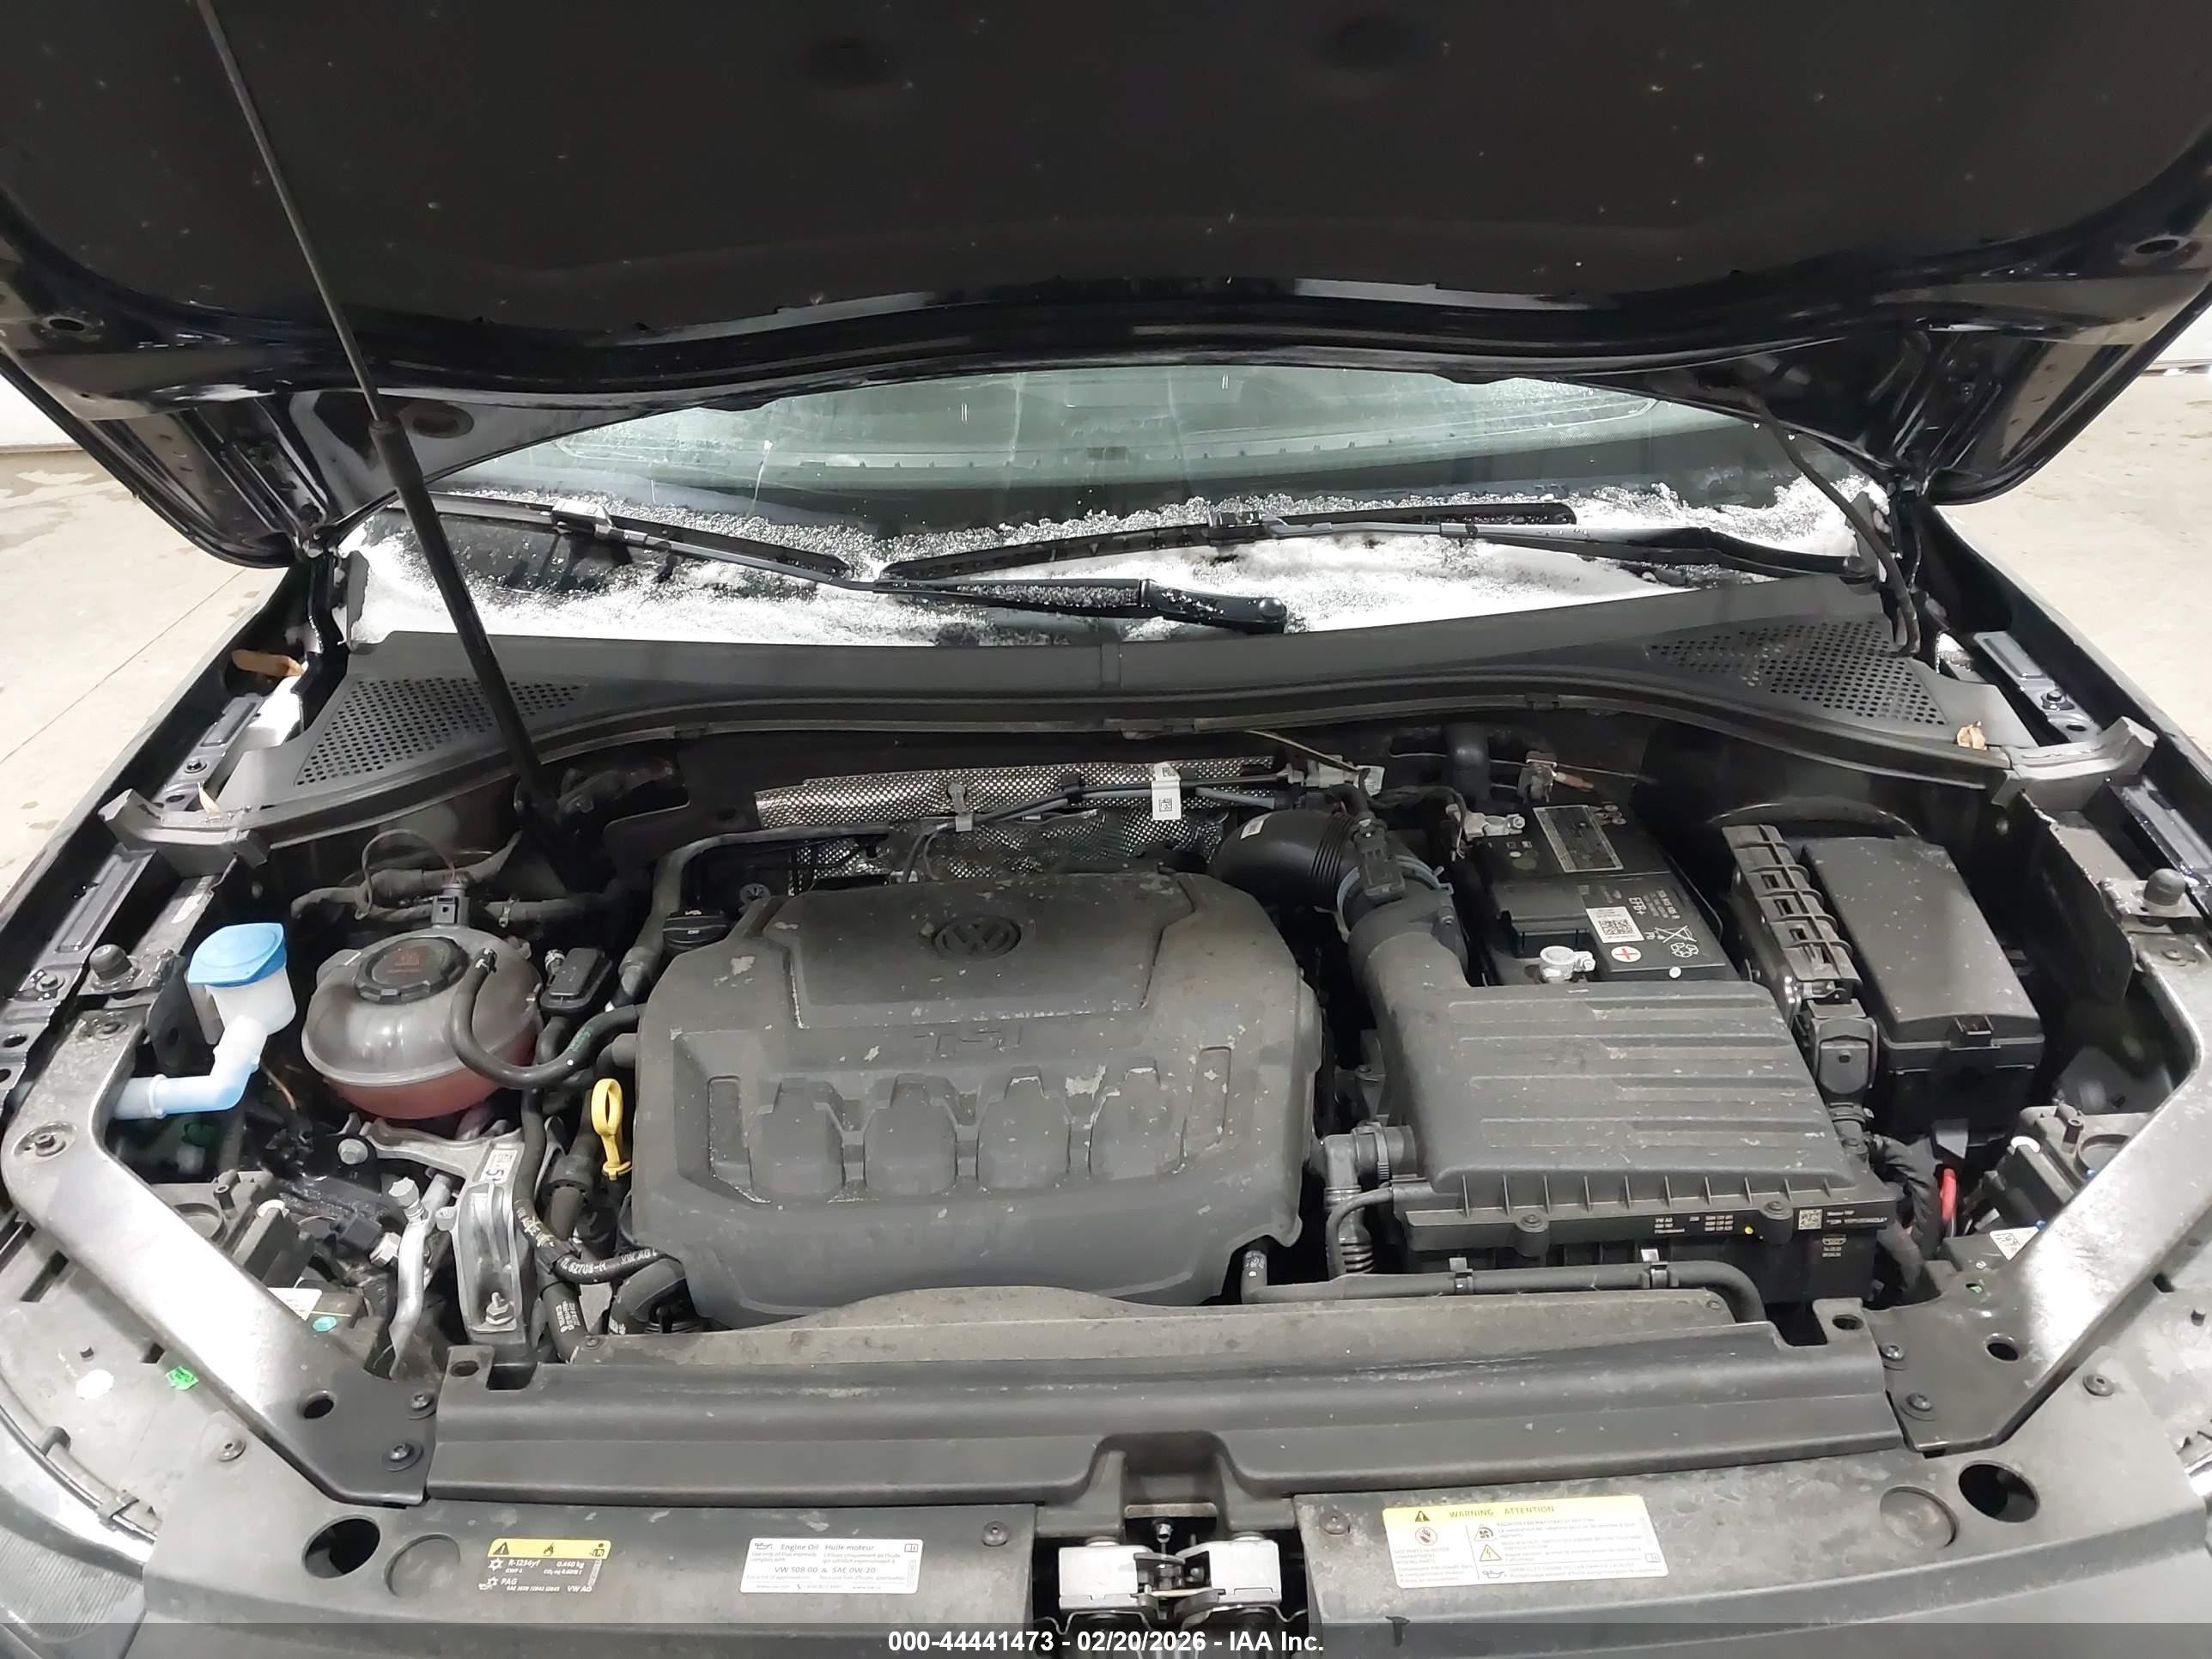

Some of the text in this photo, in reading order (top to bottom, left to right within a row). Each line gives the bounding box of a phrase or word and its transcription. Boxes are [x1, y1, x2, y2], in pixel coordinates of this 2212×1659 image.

[1449, 1505, 1555, 1519] WARNING ATTENTION
[781, 1543, 807, 1552] Engine
[507, 1559, 541, 1568] R-1234yf
[574, 1560, 585, 1569] kg
